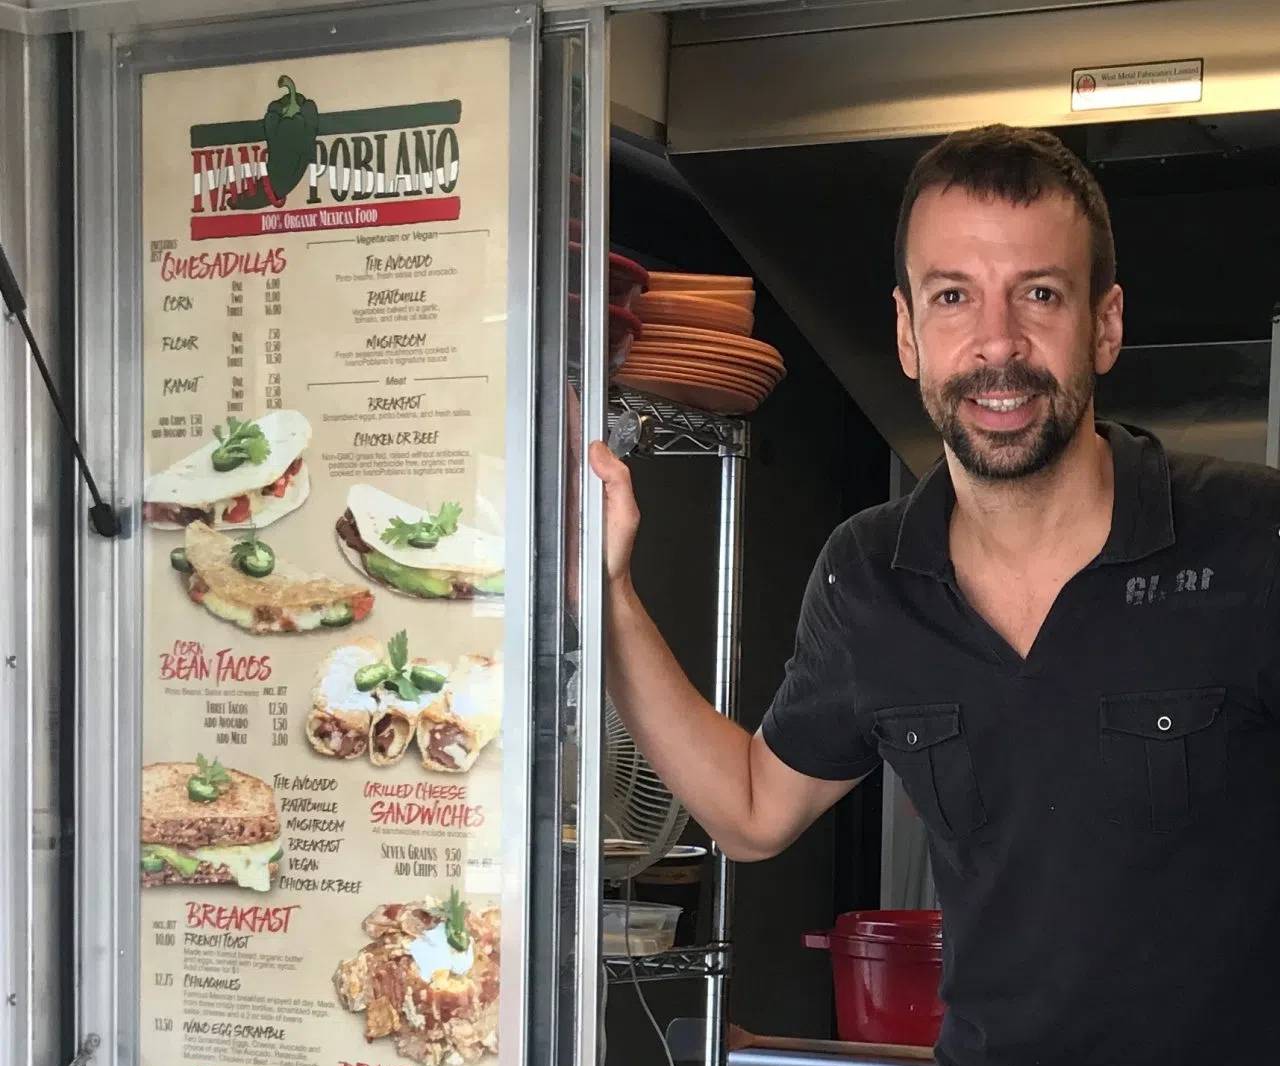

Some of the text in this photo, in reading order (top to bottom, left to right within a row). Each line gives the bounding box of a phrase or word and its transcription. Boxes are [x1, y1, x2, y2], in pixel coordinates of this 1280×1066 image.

[306, 127, 459, 204] POBLANO
[355, 208, 378, 224] FOOD
[356, 234, 399, 246] Vegetarian
[412, 231, 438, 242] Vegan
[161, 248, 286, 281] QUESADILLAS
[366, 254, 432, 274] THE AVOCADO
[163, 295, 193, 312] CORN
[162, 336, 198, 352] FLOUR
[366, 334, 426, 349] MUSHROOM
[163, 376, 204, 396] KAMUT
[386, 376, 406, 386] Meat
[368, 394, 426, 411] BREAKFAST
[354, 431, 440, 446] CHICKEN OR BEEF
[174, 640, 204, 655] CORN
[160, 648, 272, 686] BEAN TACOS
[228, 702, 248, 714] TACOS
[274, 773, 338, 793] THE AVOCADO
[364, 782, 468, 800] GRILLED CHEESE
[370, 800, 484, 828] SANDWICHES
[287, 818, 345, 832] MUSHROOM
[288, 838, 344, 852] BREAKFAST
[381, 843, 462, 862] SEVEN GRAINS 9.50
[290, 858, 320, 871] VEGAN
[394, 863, 462, 878] ADD CHIPS 1.50
[280, 876, 362, 894] CHICKEN OR BEEF
[186, 901, 302, 933] BREAKFAST
[184, 932, 253, 948] FRENCH TOAST
[212, 1024, 232, 1036] EGG
[234, 1024, 285, 1040] SCRAMBLE
